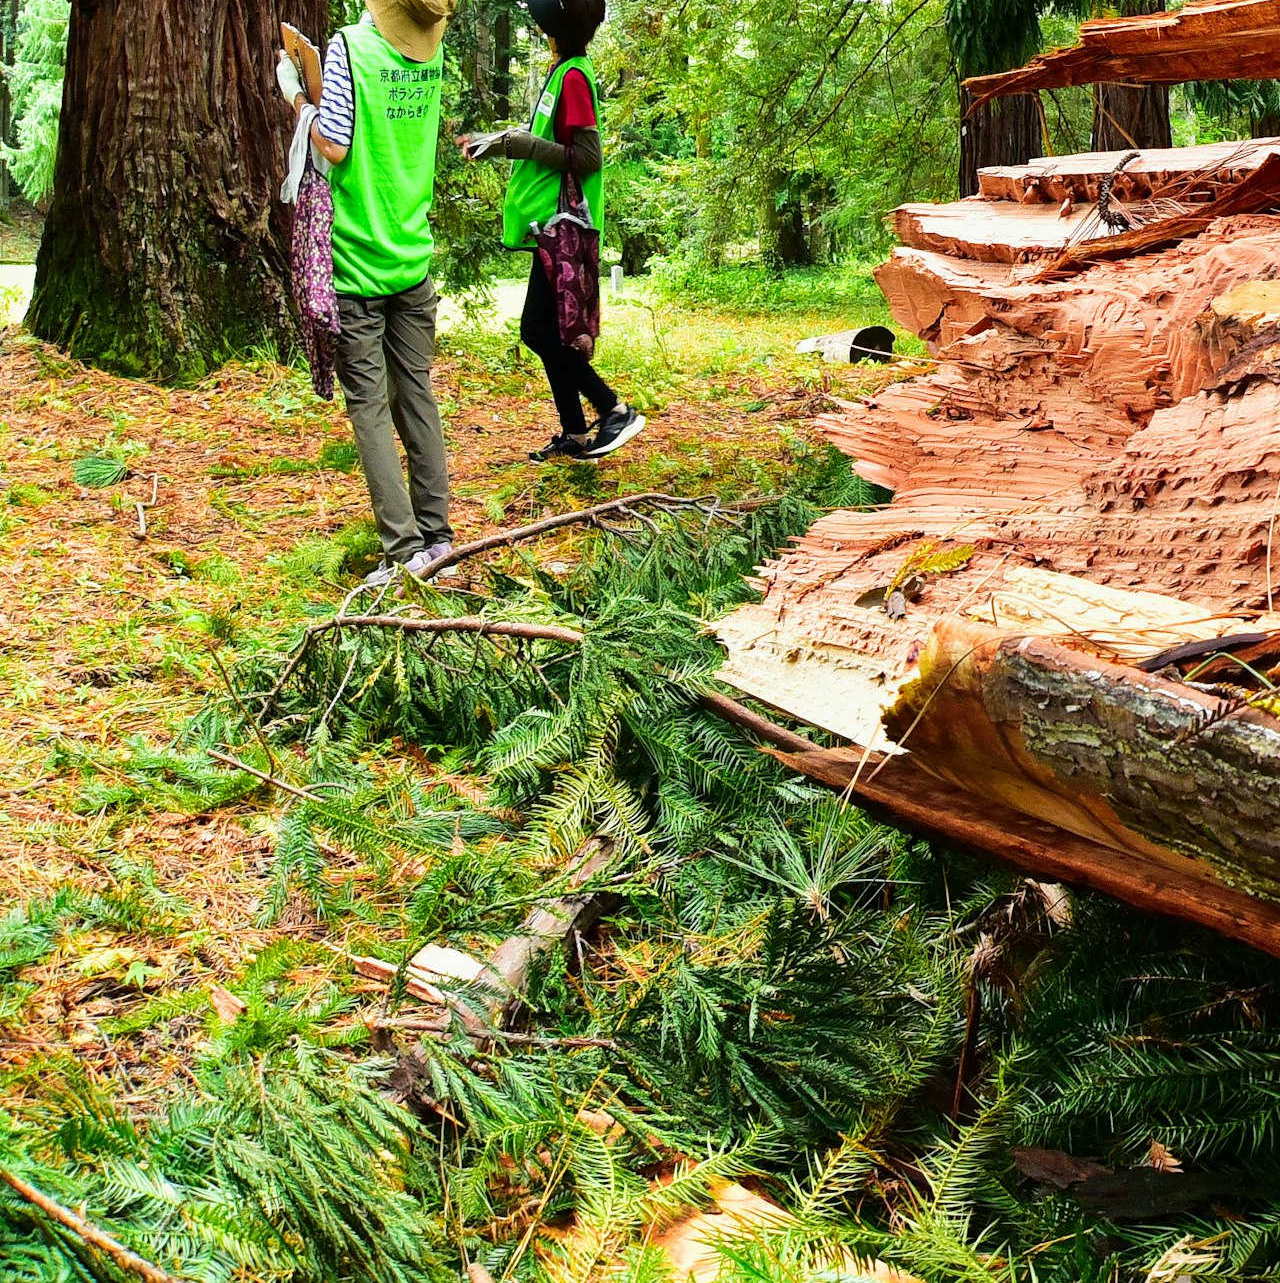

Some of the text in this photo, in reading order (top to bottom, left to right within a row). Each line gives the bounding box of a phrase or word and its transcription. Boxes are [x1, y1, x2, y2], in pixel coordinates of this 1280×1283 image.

[388, 86, 436, 101] ボランティア
